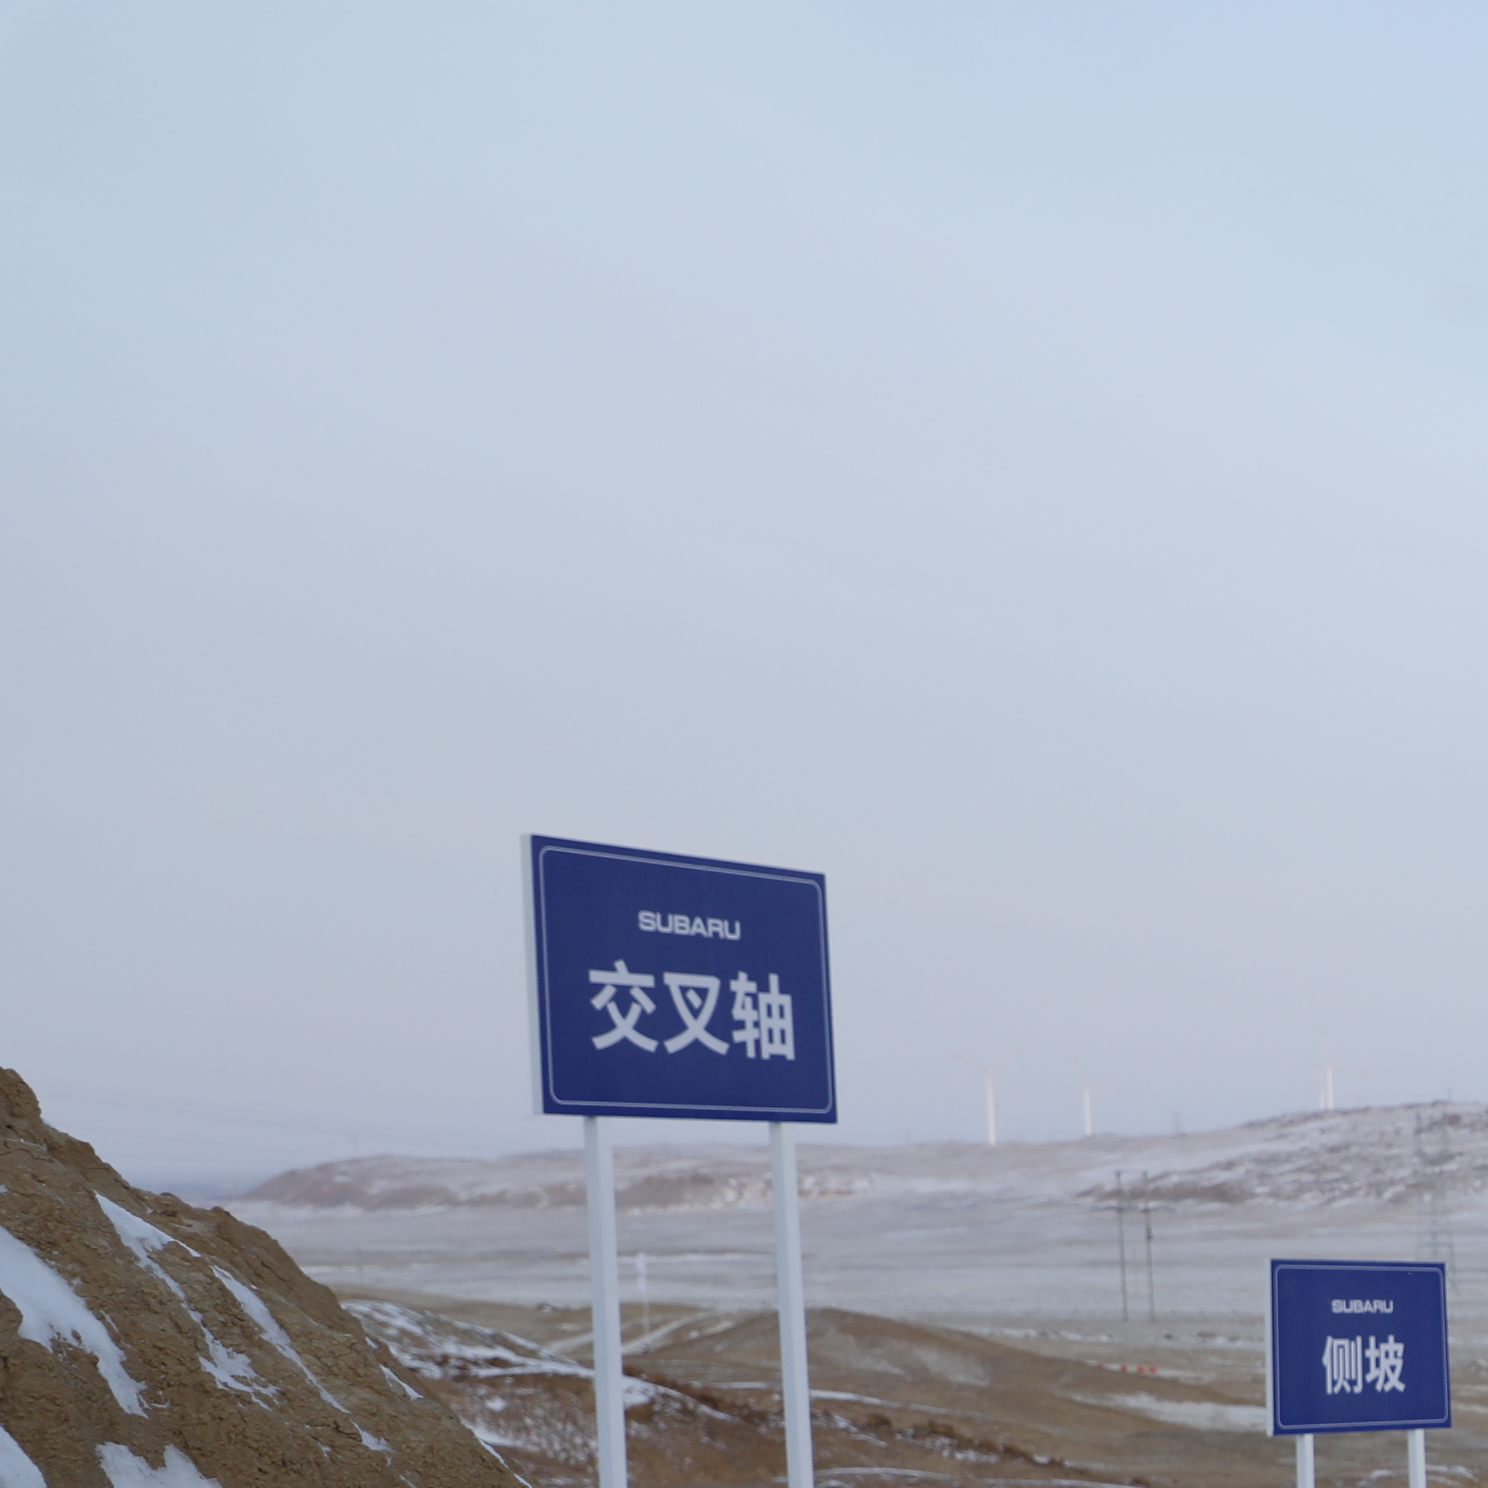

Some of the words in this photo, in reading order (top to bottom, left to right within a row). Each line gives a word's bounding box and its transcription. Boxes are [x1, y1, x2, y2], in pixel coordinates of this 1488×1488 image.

[637, 909, 742, 941] SUBARU
[588, 958, 796, 1061] 交叉轴
[1331, 1299, 1394, 1314] SUBARU
[1321, 1334, 1406, 1395] 侧坡
